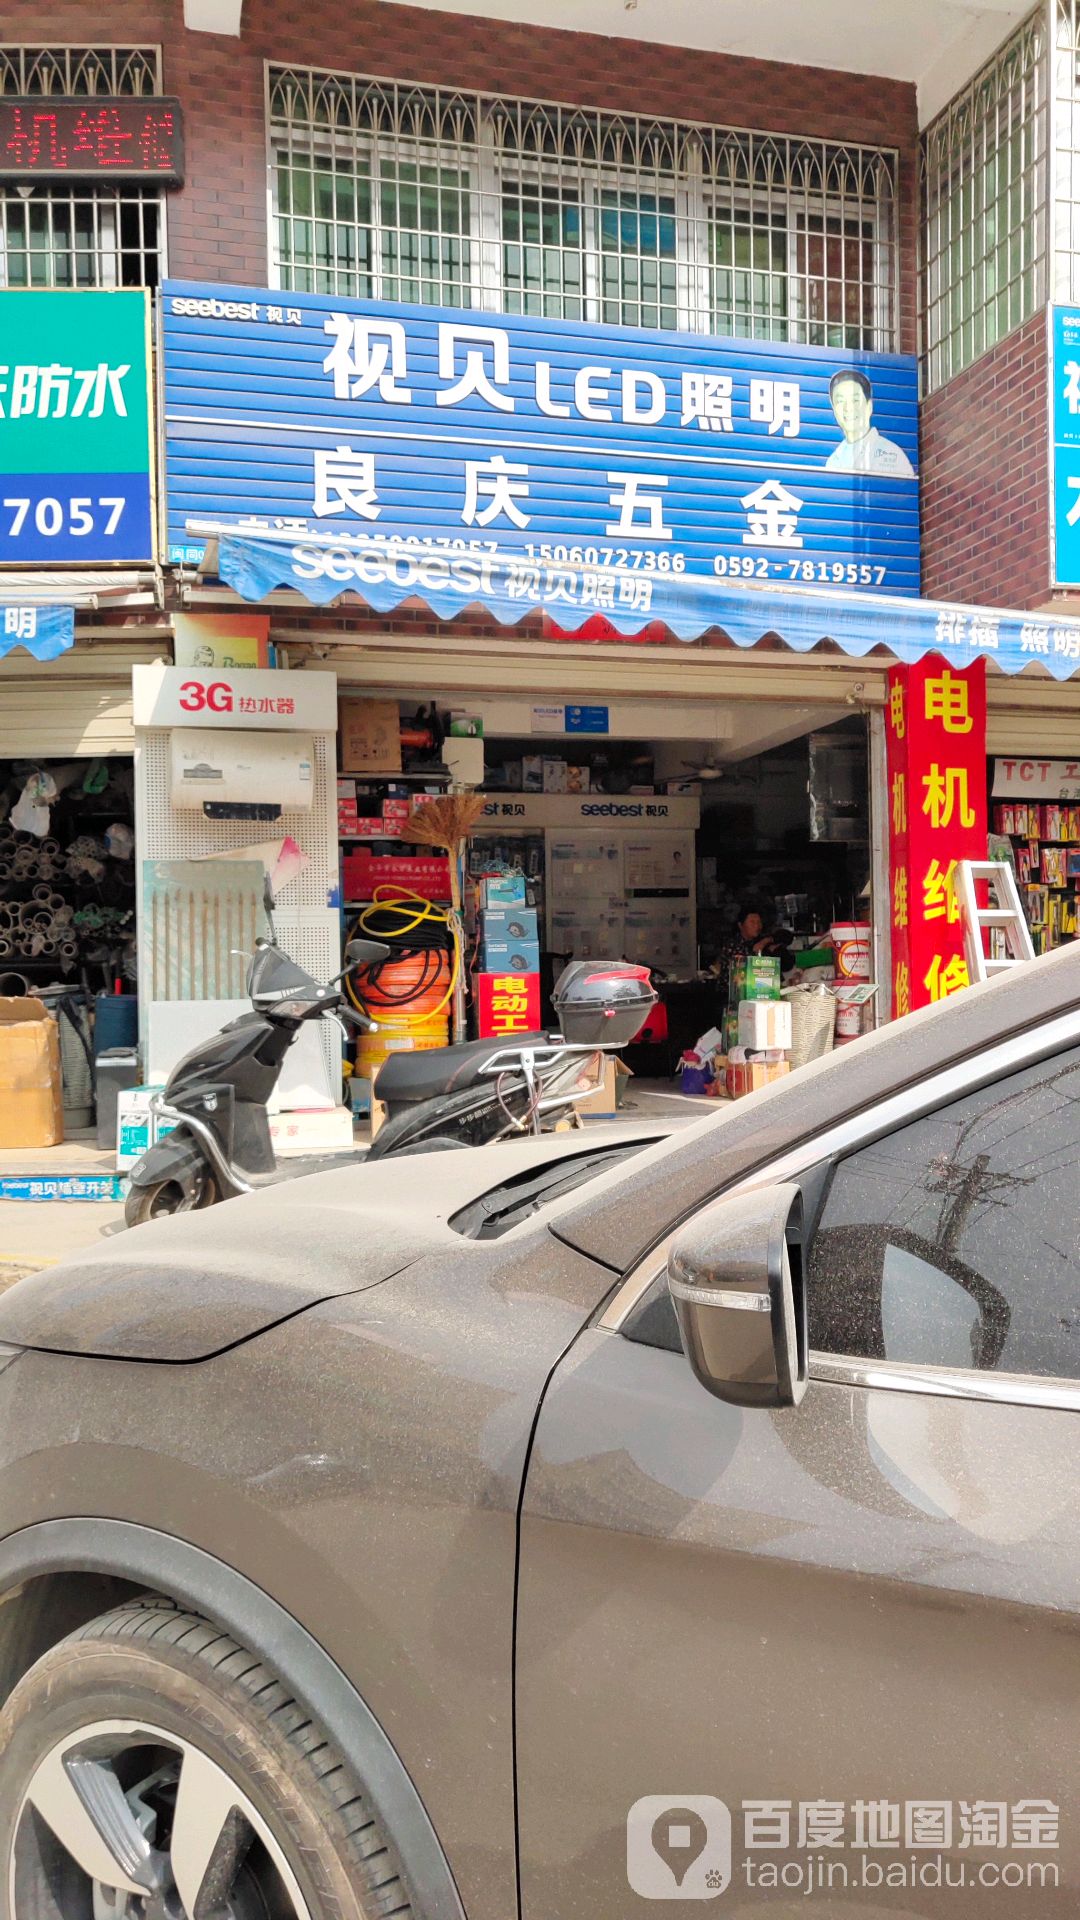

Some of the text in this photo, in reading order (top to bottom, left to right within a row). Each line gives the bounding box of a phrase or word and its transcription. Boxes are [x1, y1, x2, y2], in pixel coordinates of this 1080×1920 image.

[171, 297, 302, 326] seebest 视贝
[311, 445, 804, 548] 良庆五金
[3, 497, 126, 536] 7057
[290, 544, 653, 613] seebest 视贝照明
[524, 543, 887, 586] 15060727366 0592-7819557
[4, 606, 37, 639] 明
[179, 681, 296, 715] 3G 热水器
[1002, 761, 1052, 782] TCT
[501, 803, 526, 817] 视贝
[580, 802, 669, 817] seebest 视贝
[491, 976, 529, 1038] 电动工
